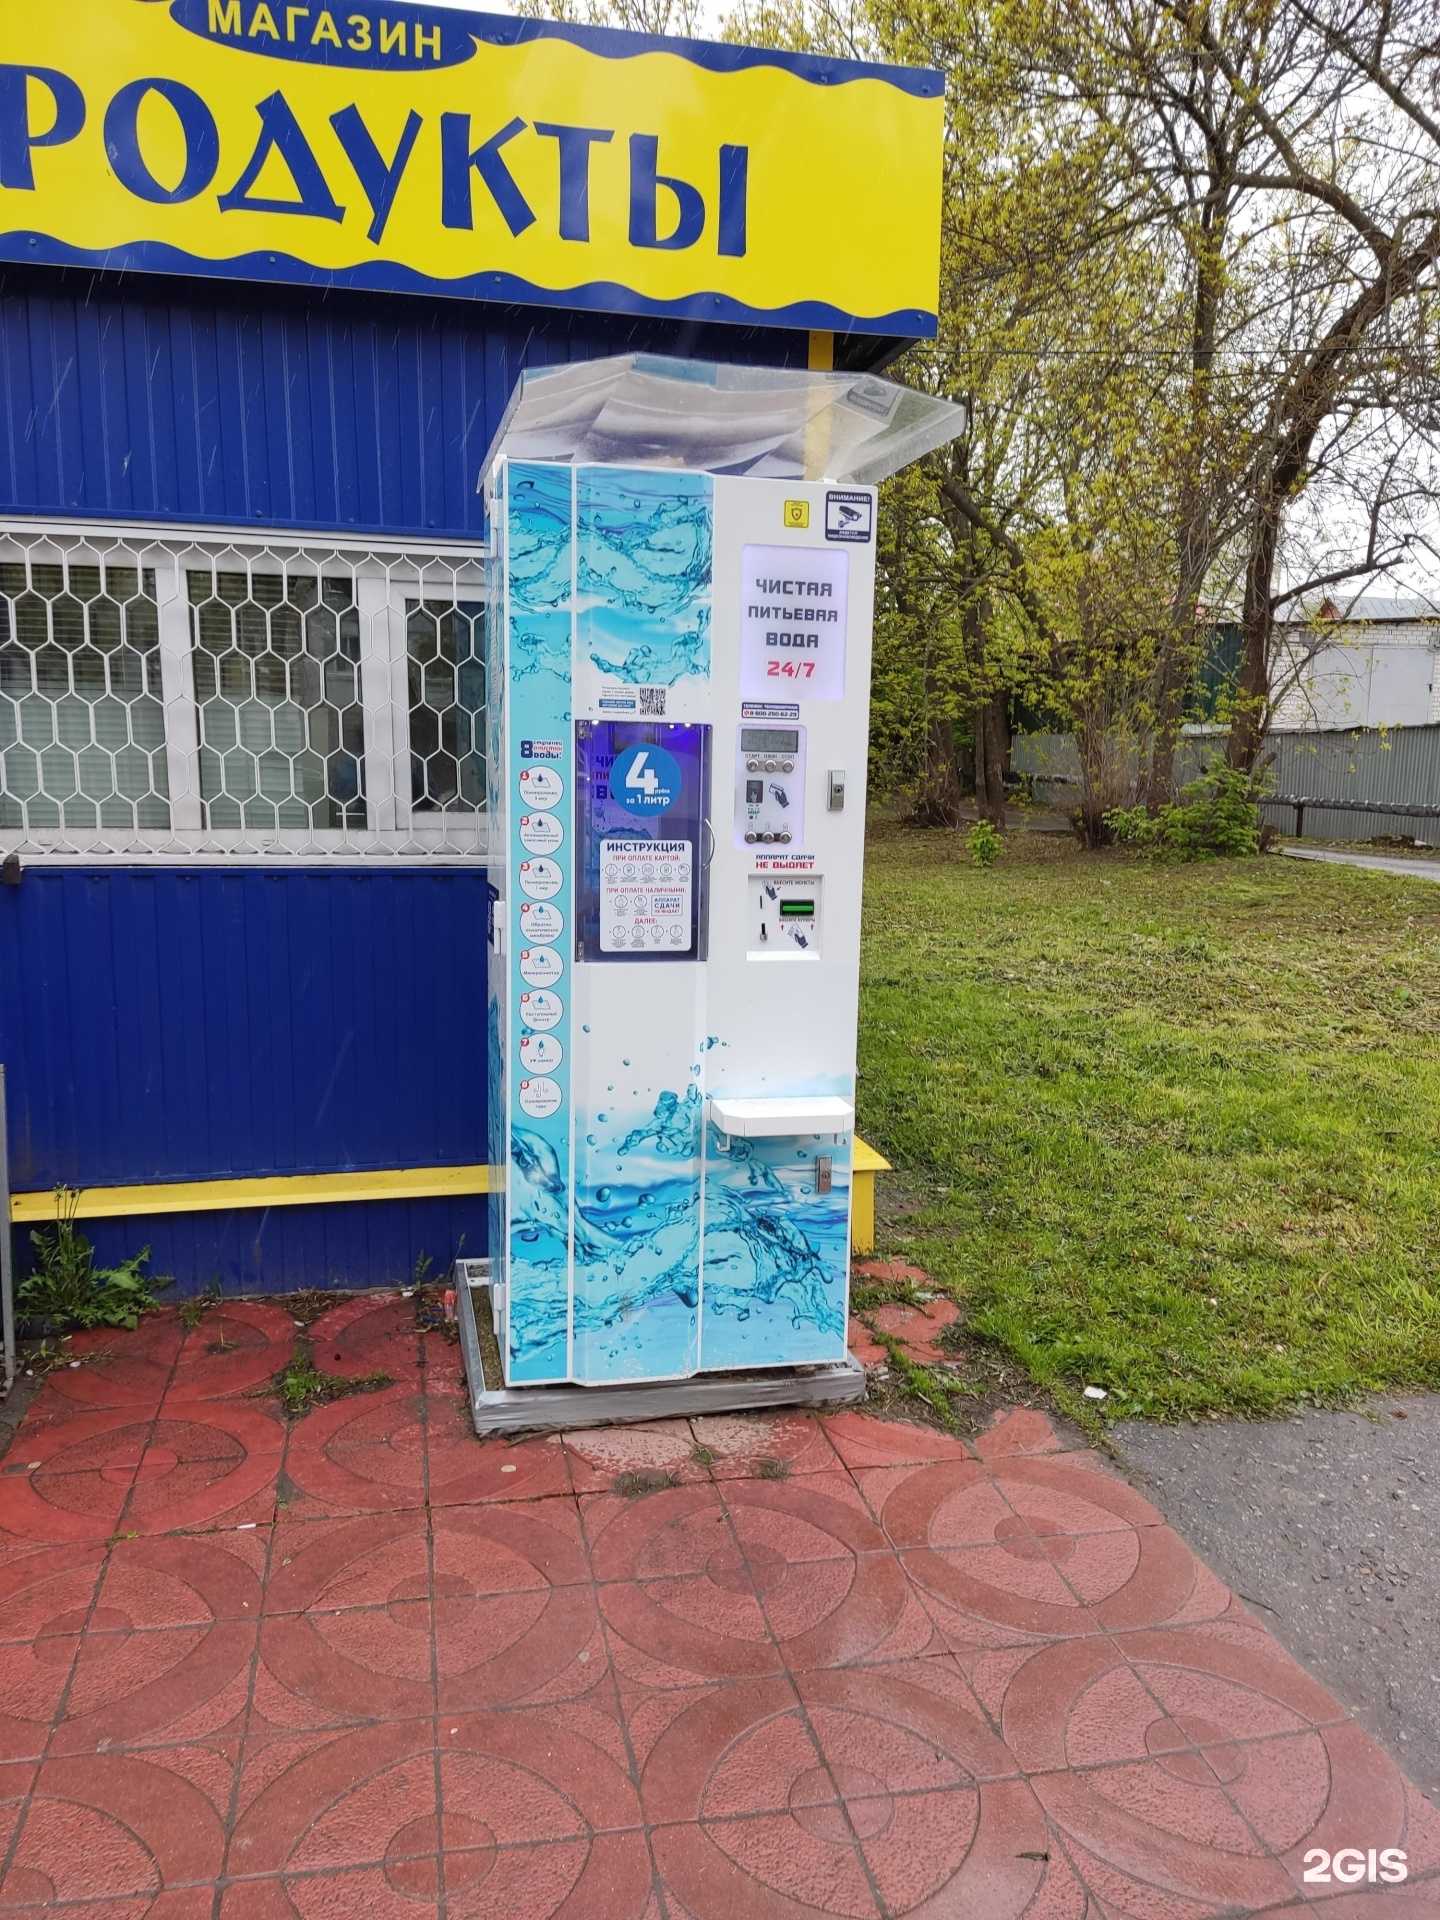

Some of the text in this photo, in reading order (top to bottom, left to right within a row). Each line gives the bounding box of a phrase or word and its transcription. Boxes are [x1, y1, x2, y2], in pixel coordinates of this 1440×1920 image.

[208, 0, 442, 60] МАГАЗИН
[828, 494, 871, 503] ВНИМАНИЕ!
[755, 578, 833, 597] ЧИСТАЯ
[748, 605, 838, 622] ПИТЬЕВАЯ
[765, 632, 819, 648] ВОДА
[767, 661, 816, 679] 24/7
[521, 740, 533, 758] 8
[625, 752, 659, 795] 4
[637, 794, 642, 804] 1
[644, 795, 670, 807] литр
[607, 842, 685, 853] ИНСТРУКЦИЯ
[755, 861, 814, 869] НЕ ВЫДАЕТ
